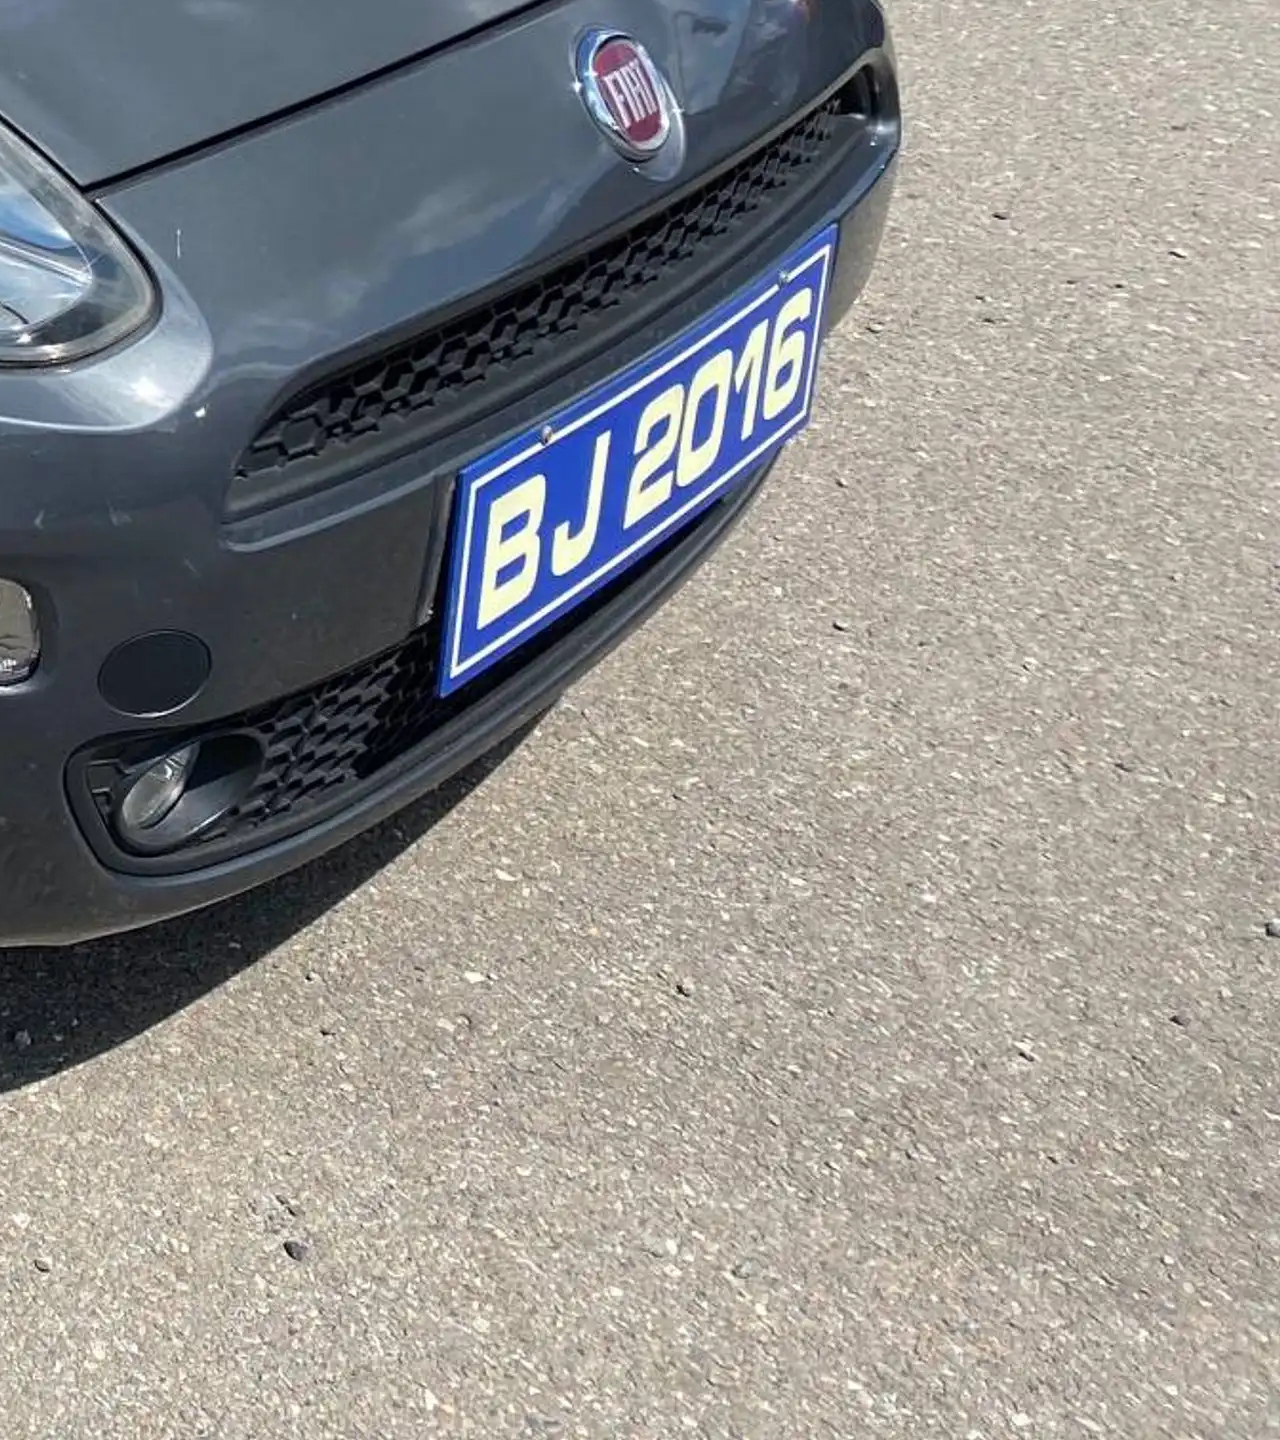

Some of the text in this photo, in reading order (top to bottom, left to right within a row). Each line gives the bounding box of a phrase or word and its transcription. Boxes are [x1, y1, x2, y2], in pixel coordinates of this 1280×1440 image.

[603, 58, 659, 129] FIAT
[477, 288, 813, 630] BJ 2016
